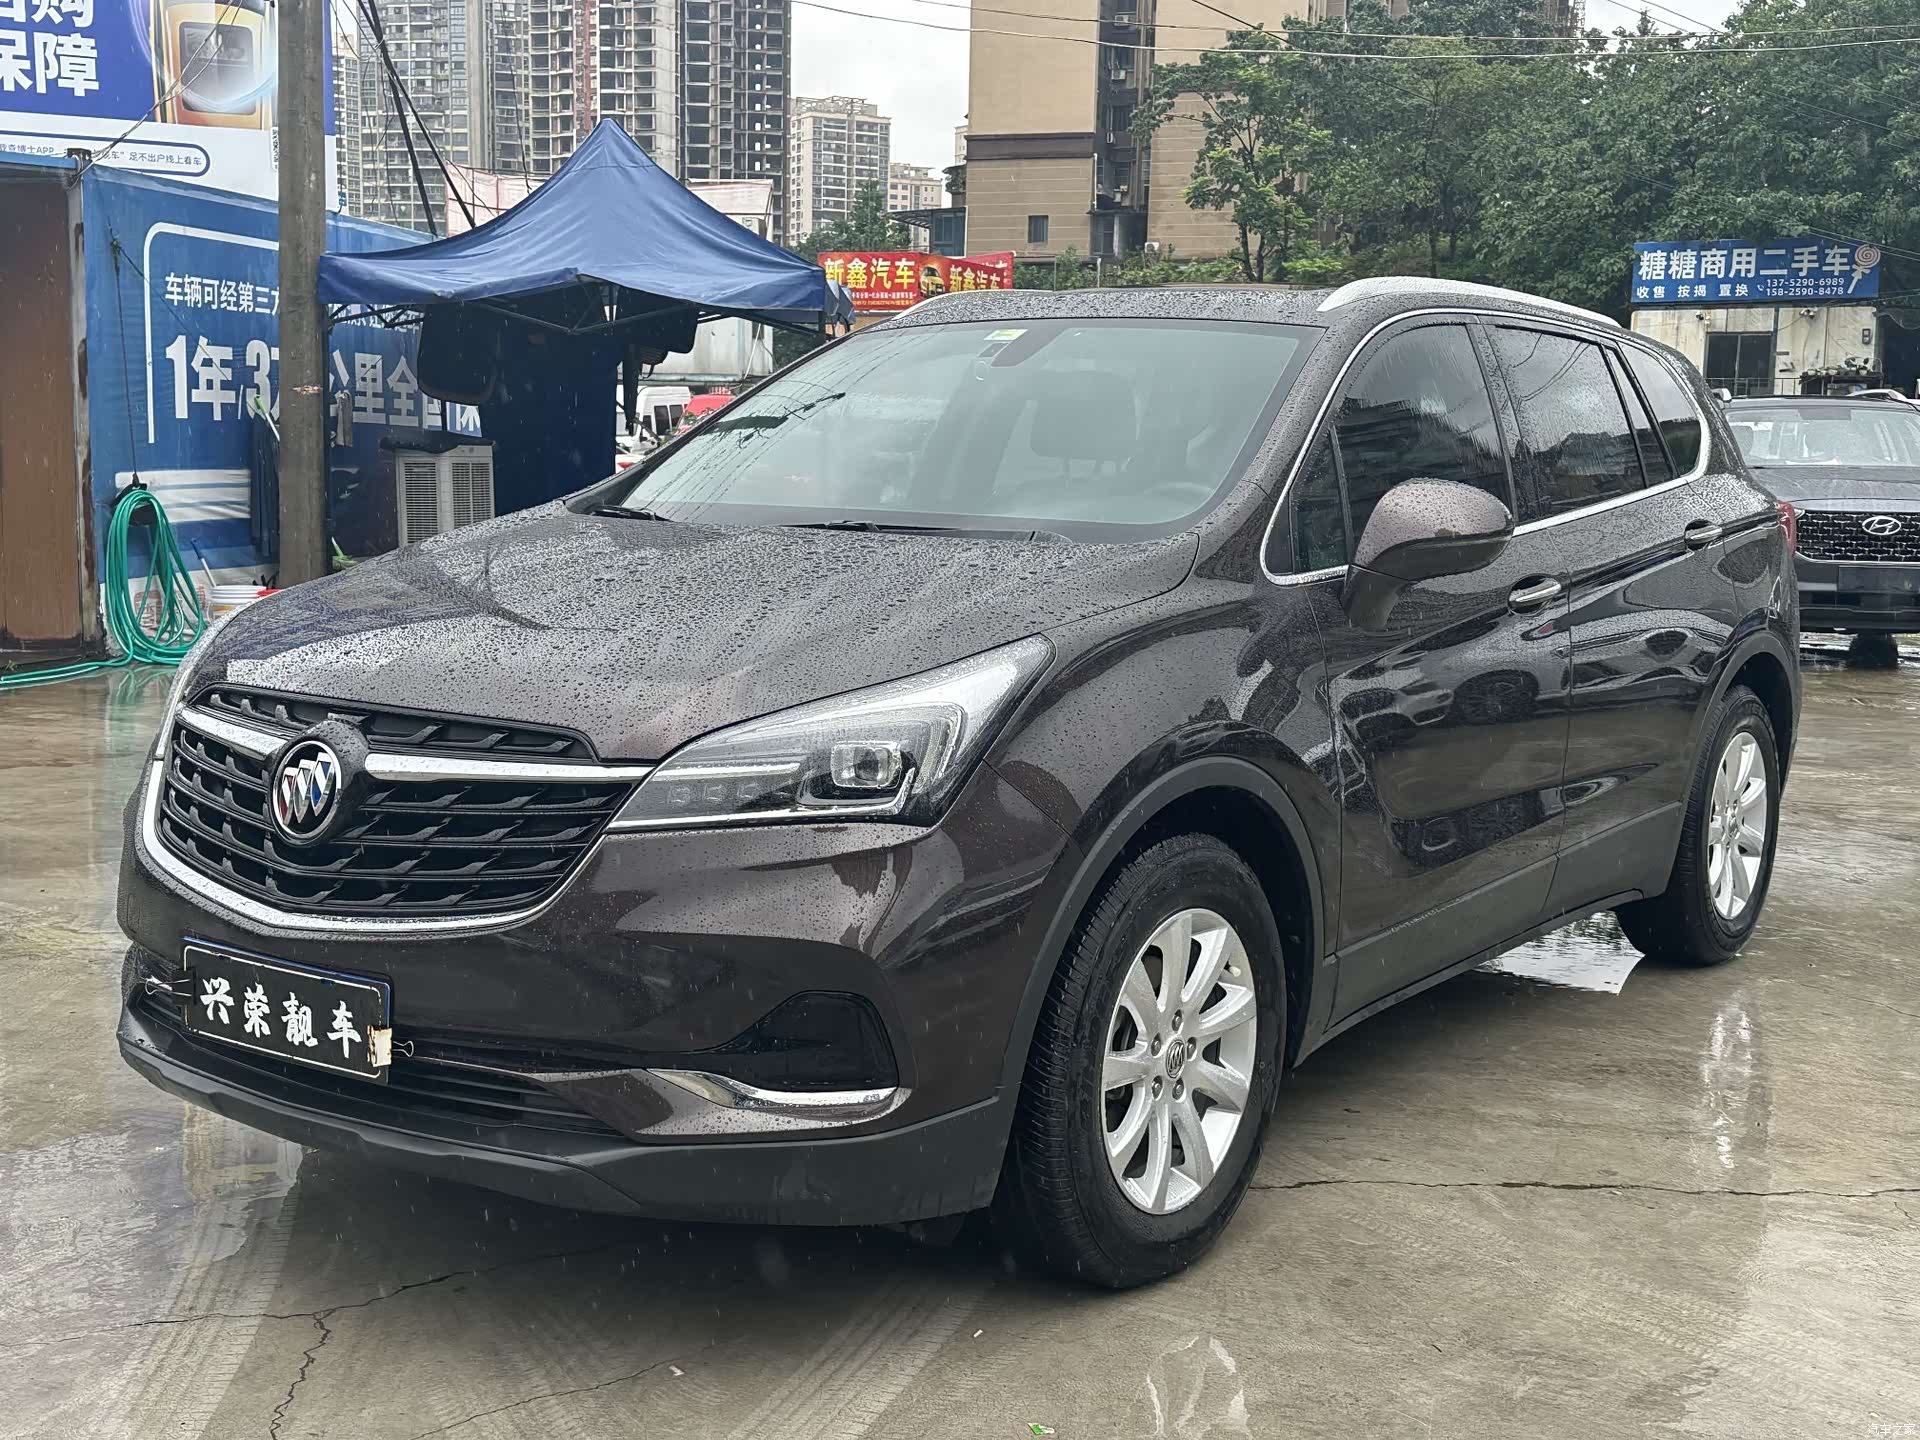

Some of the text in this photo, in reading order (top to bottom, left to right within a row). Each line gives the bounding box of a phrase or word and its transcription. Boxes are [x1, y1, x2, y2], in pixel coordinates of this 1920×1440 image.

[824, 258, 915, 289] 新鑫汽车
[1638, 245, 1850, 280] 糖糖商用二手车
[1637, 283, 1749, 299] 收售 按揭 置换
[1766, 278, 1845, 288] 137-5290-6989
[1766, 286, 1844, 296] 158-2590-8478
[200, 977, 362, 1058] 兴荣靓车
